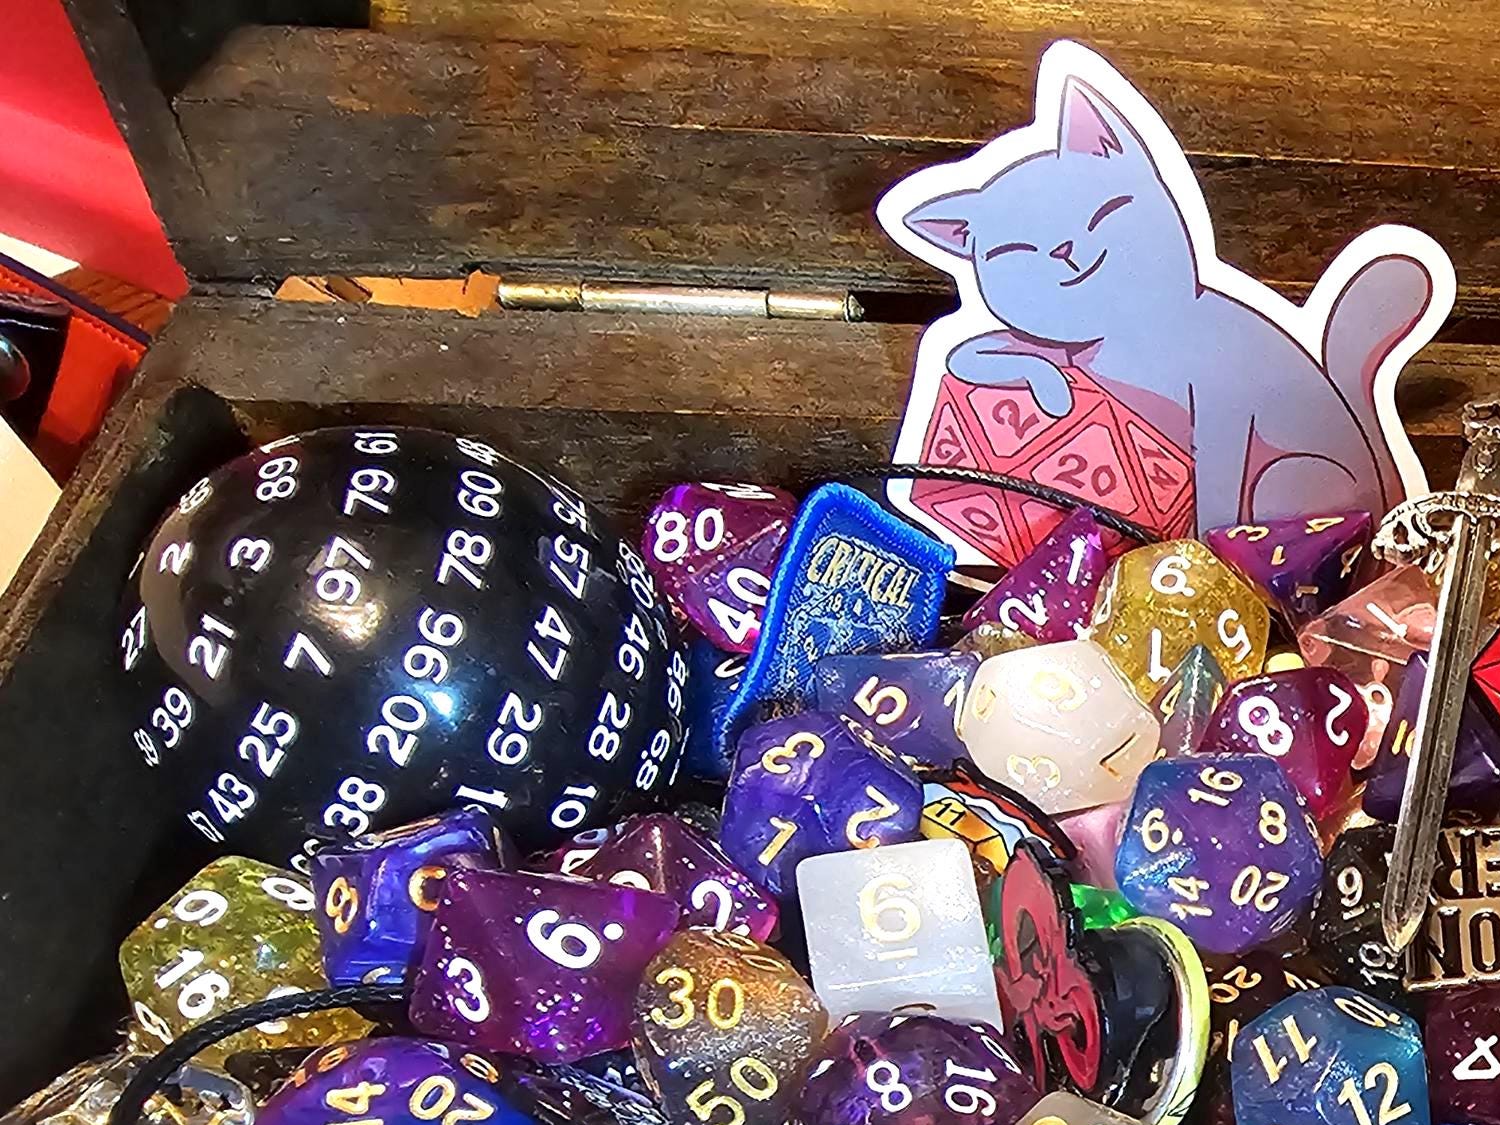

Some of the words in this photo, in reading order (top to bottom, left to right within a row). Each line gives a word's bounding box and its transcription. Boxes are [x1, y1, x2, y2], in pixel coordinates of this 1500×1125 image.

[344, 469, 396, 517] 79
[1058, 456, 1117, 495] 20
[161, 542, 192, 574] 2
[230, 538, 272, 572] 3
[436, 530, 490, 590] 78
[652, 508, 724, 562] 80
[1069, 536, 1088, 584] 1
[317, 536, 373, 604] 97
[549, 536, 588, 599] 57
[806, 536, 921, 609] CRITICAL
[188, 614, 237, 679] 21
[284, 633, 333, 678] 7
[527, 606, 573, 681] 47
[153, 687, 195, 748] 39
[488, 692, 542, 766] 29
[588, 692, 630, 761] 28
[853, 677, 907, 724] 5
[1238, 697, 1293, 757] 8
[239, 702, 297, 777] 25
[366, 695, 426, 767] 20
[761, 732, 826, 774] 3
[207, 773, 256, 826] 43
[324, 776, 385, 836] 38
[935, 803, 966, 826] 11
[1190, 766, 1242, 805] 16
[847, 787, 899, 849] 2
[1258, 801, 1287, 843] 8
[1170, 873, 1210, 921] 14
[1231, 865, 1289, 912] 20
[155, 949, 230, 1019] 16
[448, 958, 490, 1022] 3
[651, 968, 743, 1030] 30
[1254, 1016, 1318, 1084] 11
[868, 1060, 912, 1112] 8
[945, 1058, 998, 1116] 16
